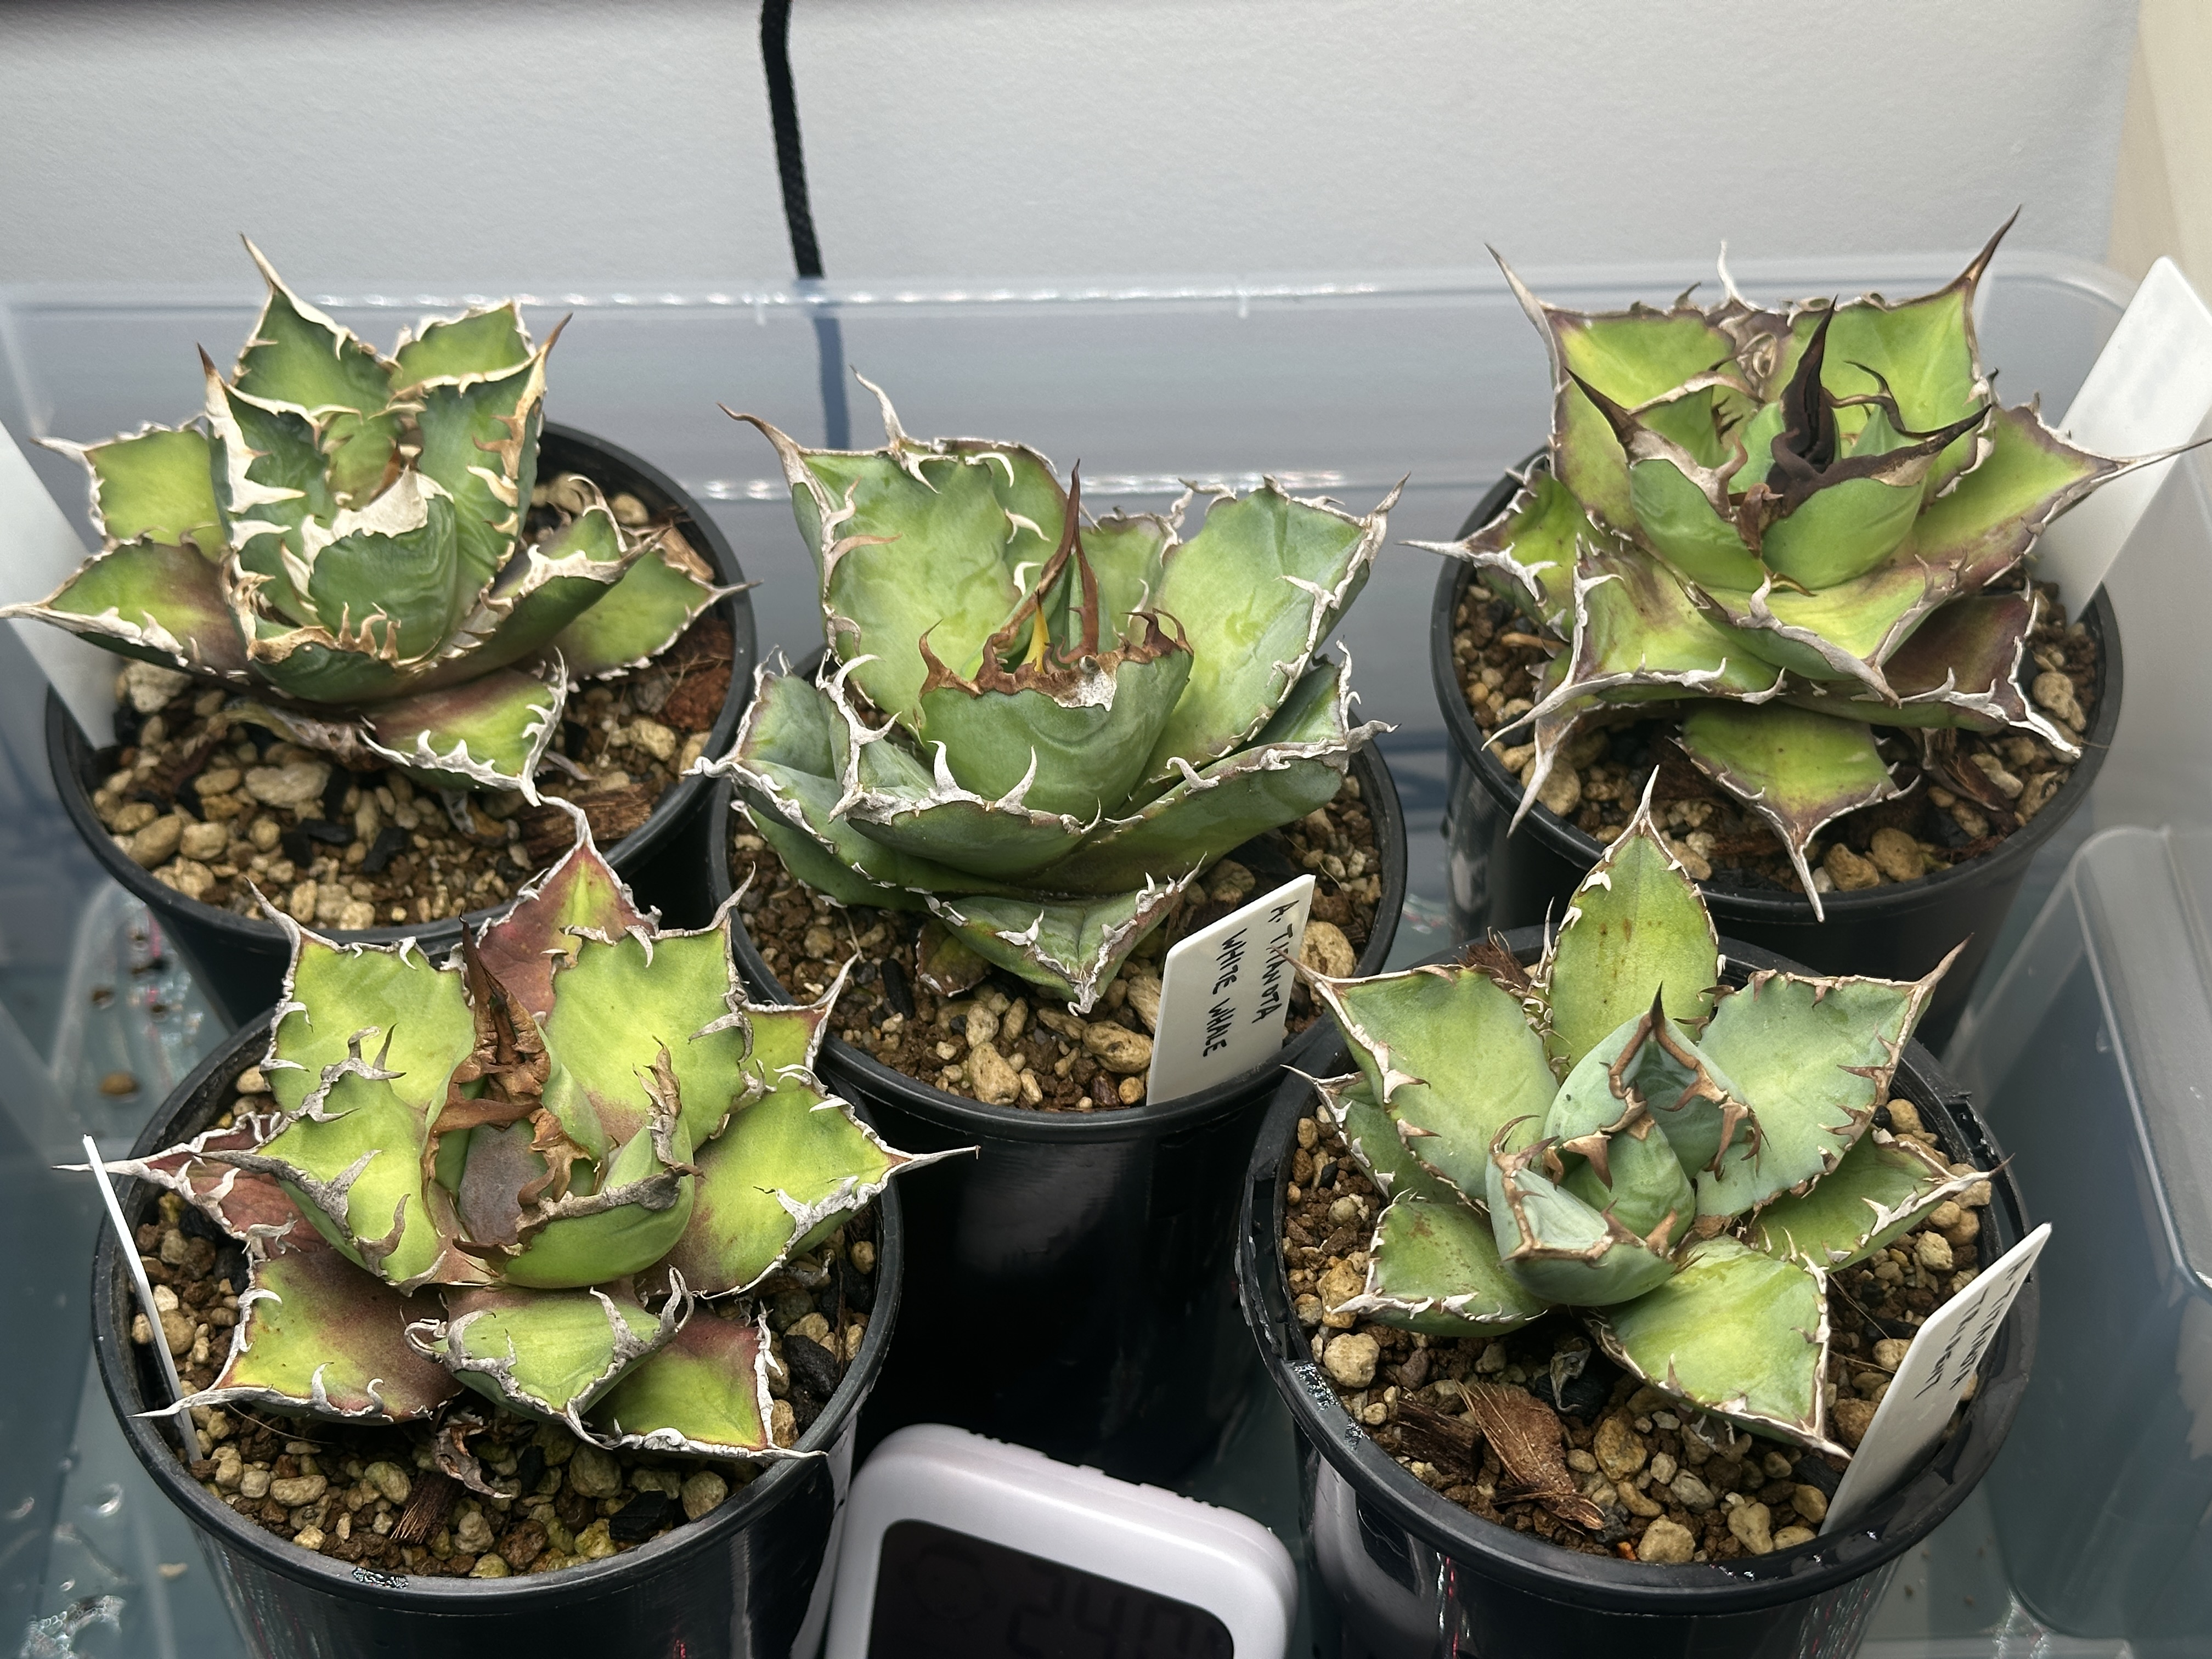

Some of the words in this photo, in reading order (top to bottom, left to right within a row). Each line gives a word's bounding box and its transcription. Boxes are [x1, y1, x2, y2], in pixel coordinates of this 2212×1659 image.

[1267, 900, 1300, 923] A.
[1212, 928, 1248, 995] WHITE
[1251, 923, 1293, 1024] TITANOTA
[1203, 997, 1236, 1057] WHALE
